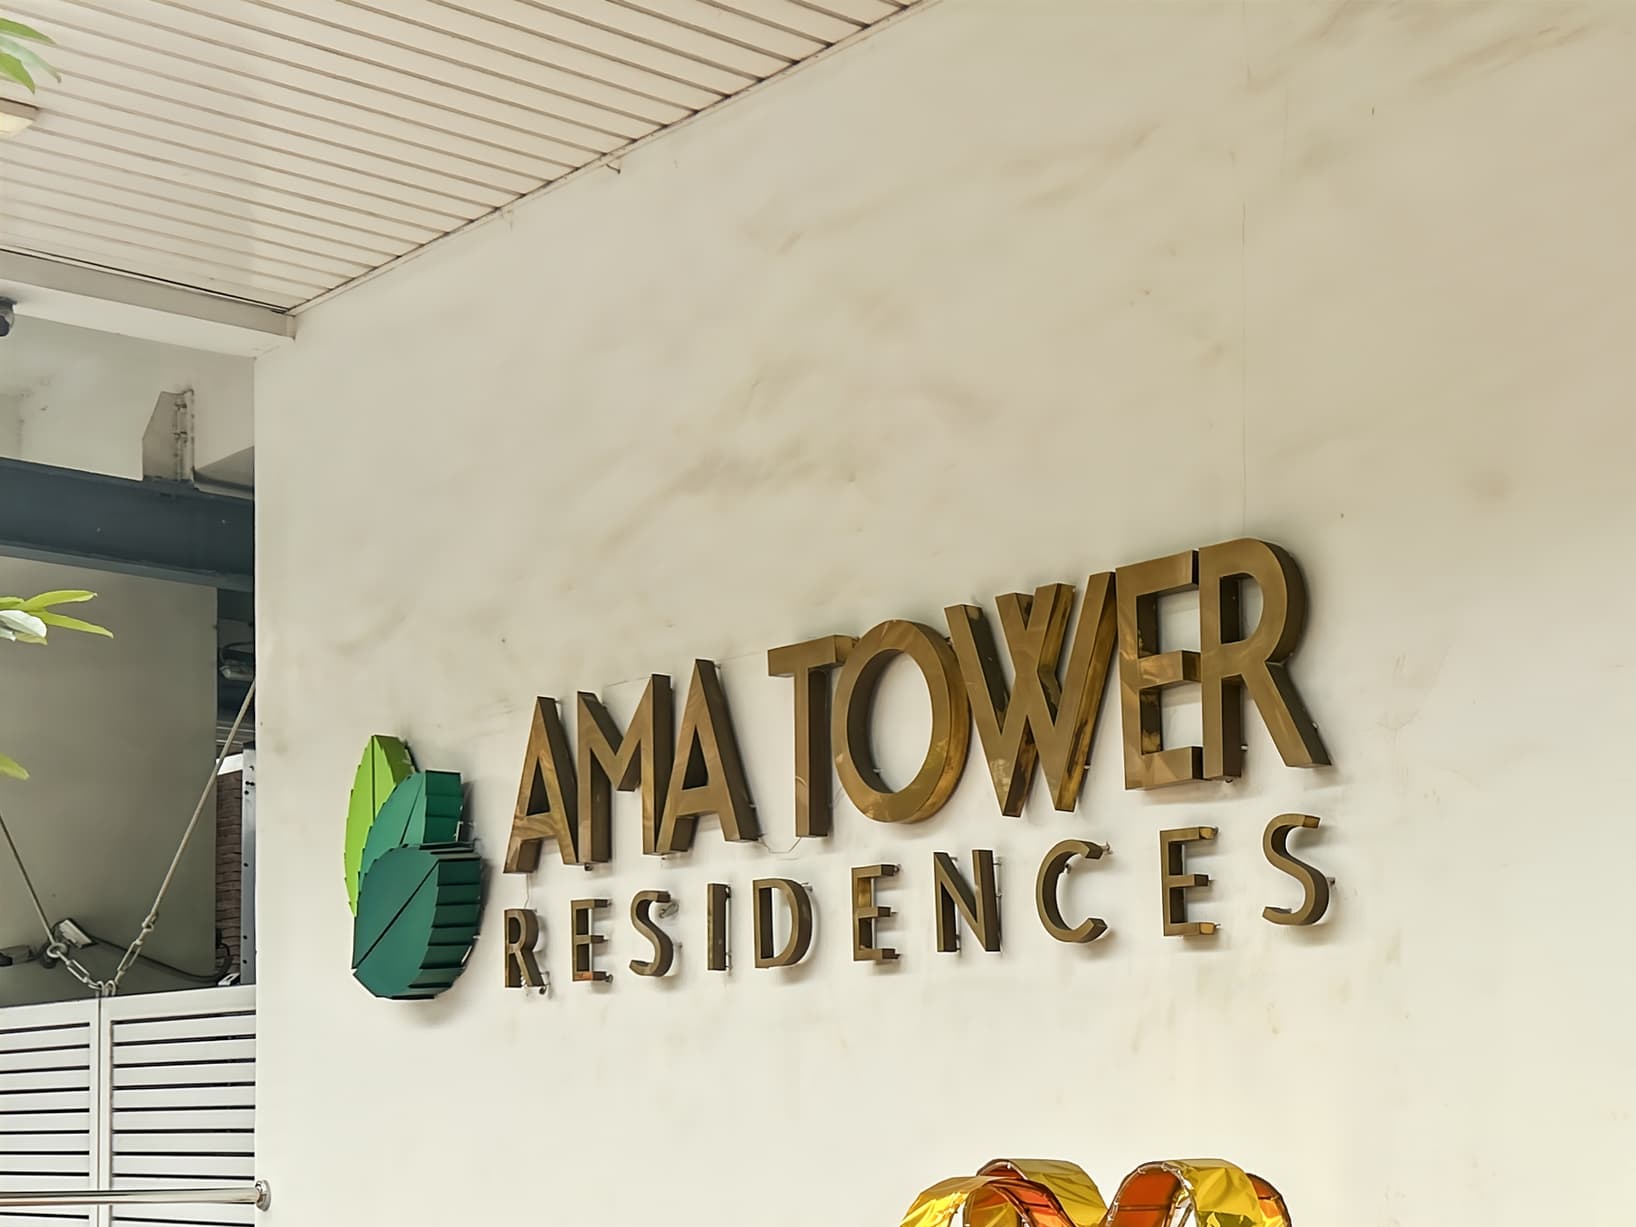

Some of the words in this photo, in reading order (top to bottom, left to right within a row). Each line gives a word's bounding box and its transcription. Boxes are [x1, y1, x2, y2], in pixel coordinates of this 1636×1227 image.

[502, 658, 760, 874] AMA
[767, 537, 1332, 840] TOWER
[504, 813, 1332, 989] RESIDENCES
